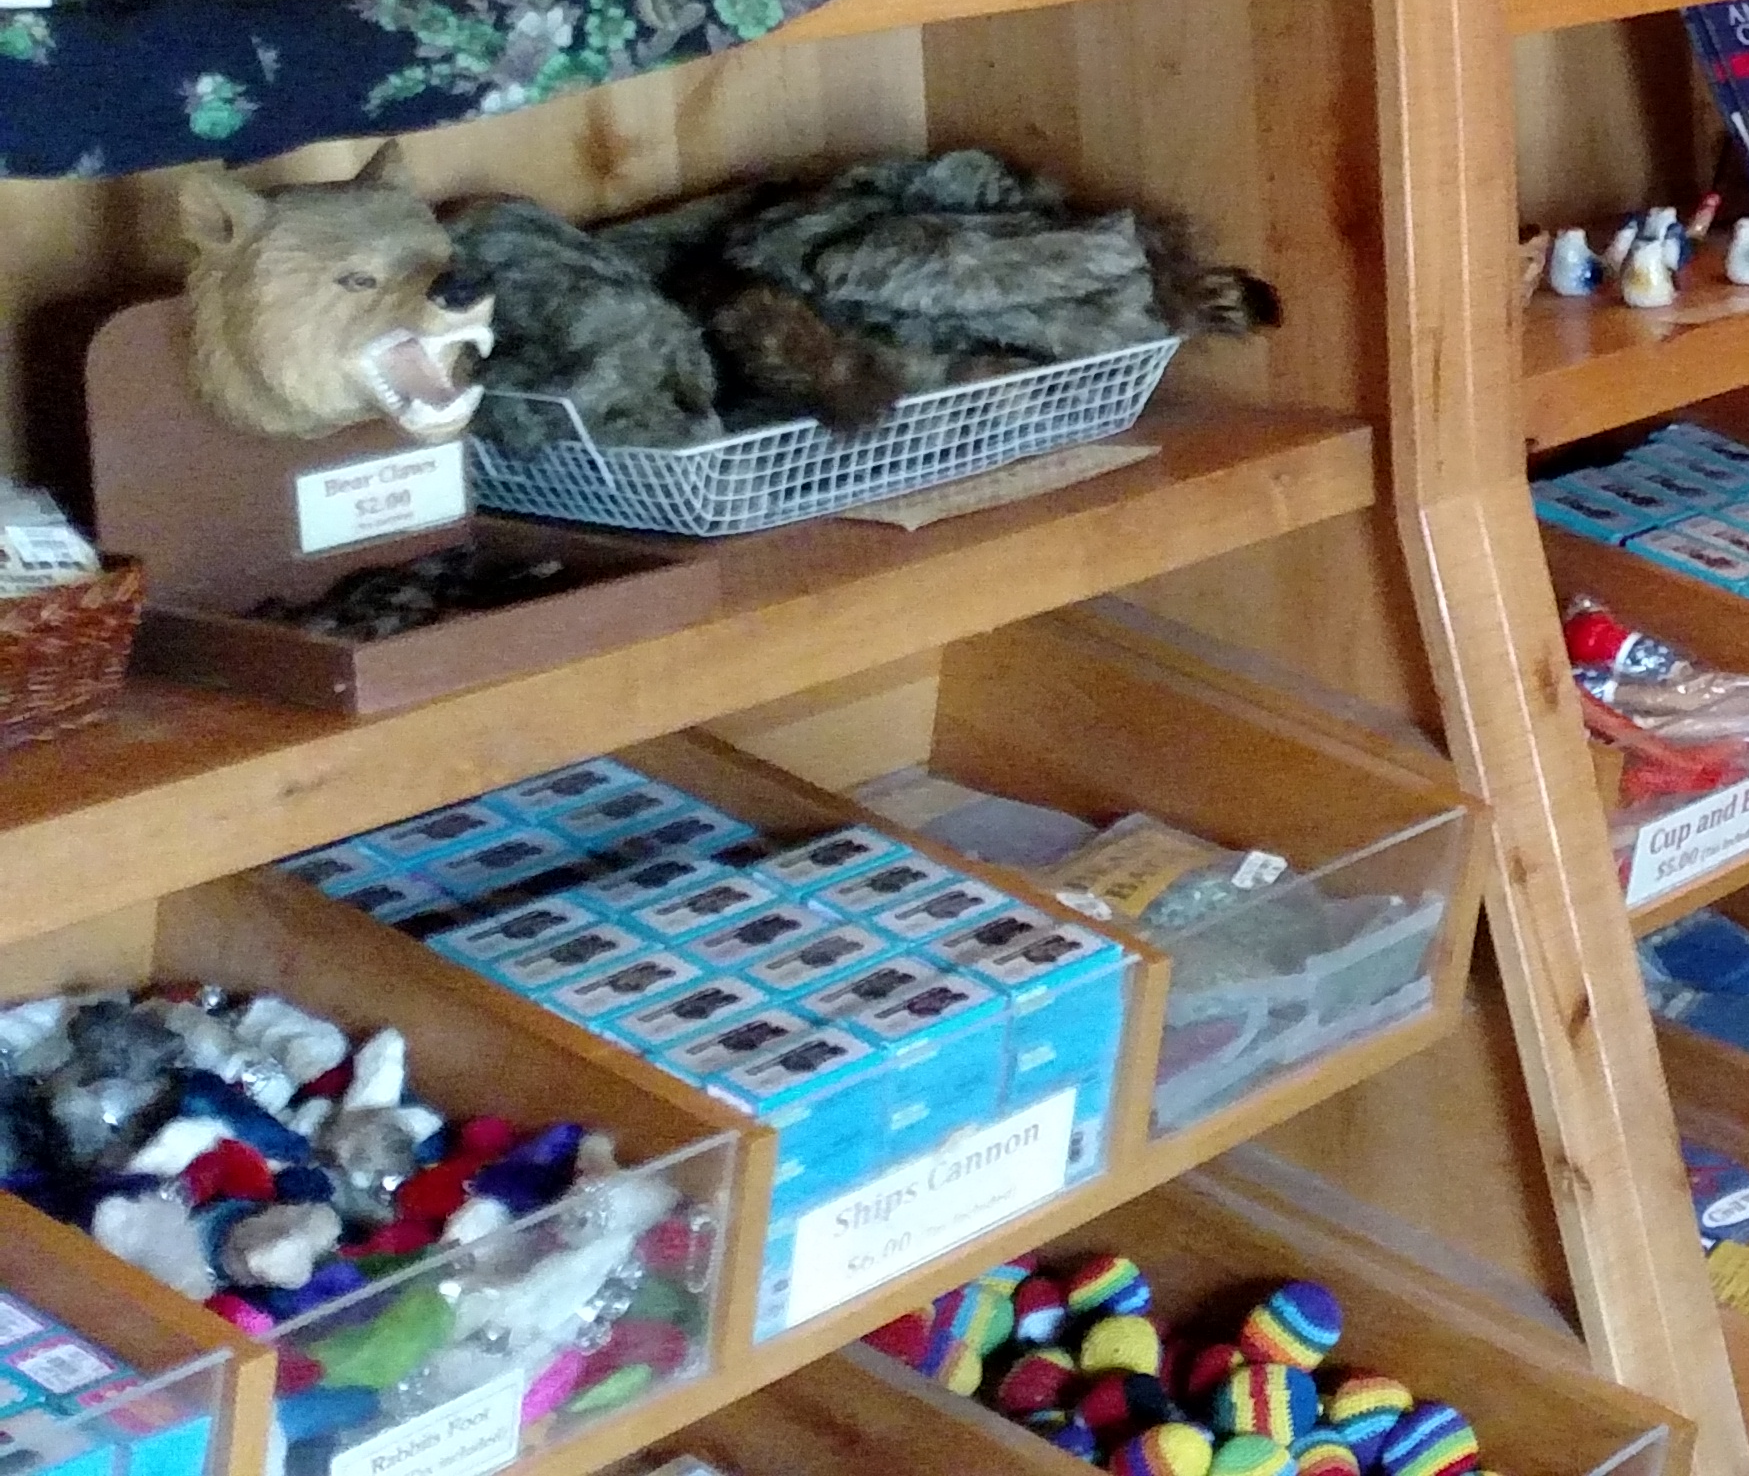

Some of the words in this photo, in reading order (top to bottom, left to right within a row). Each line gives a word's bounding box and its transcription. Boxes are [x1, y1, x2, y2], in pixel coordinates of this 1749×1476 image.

[324, 475, 373, 498] Bear
[1650, 823, 1691, 854] Cup
[1696, 794, 1738, 834] and
[1656, 846, 1699, 881] $5.00
[832, 1180, 920, 1238] Ships
[927, 1123, 1040, 1192] Cannon
